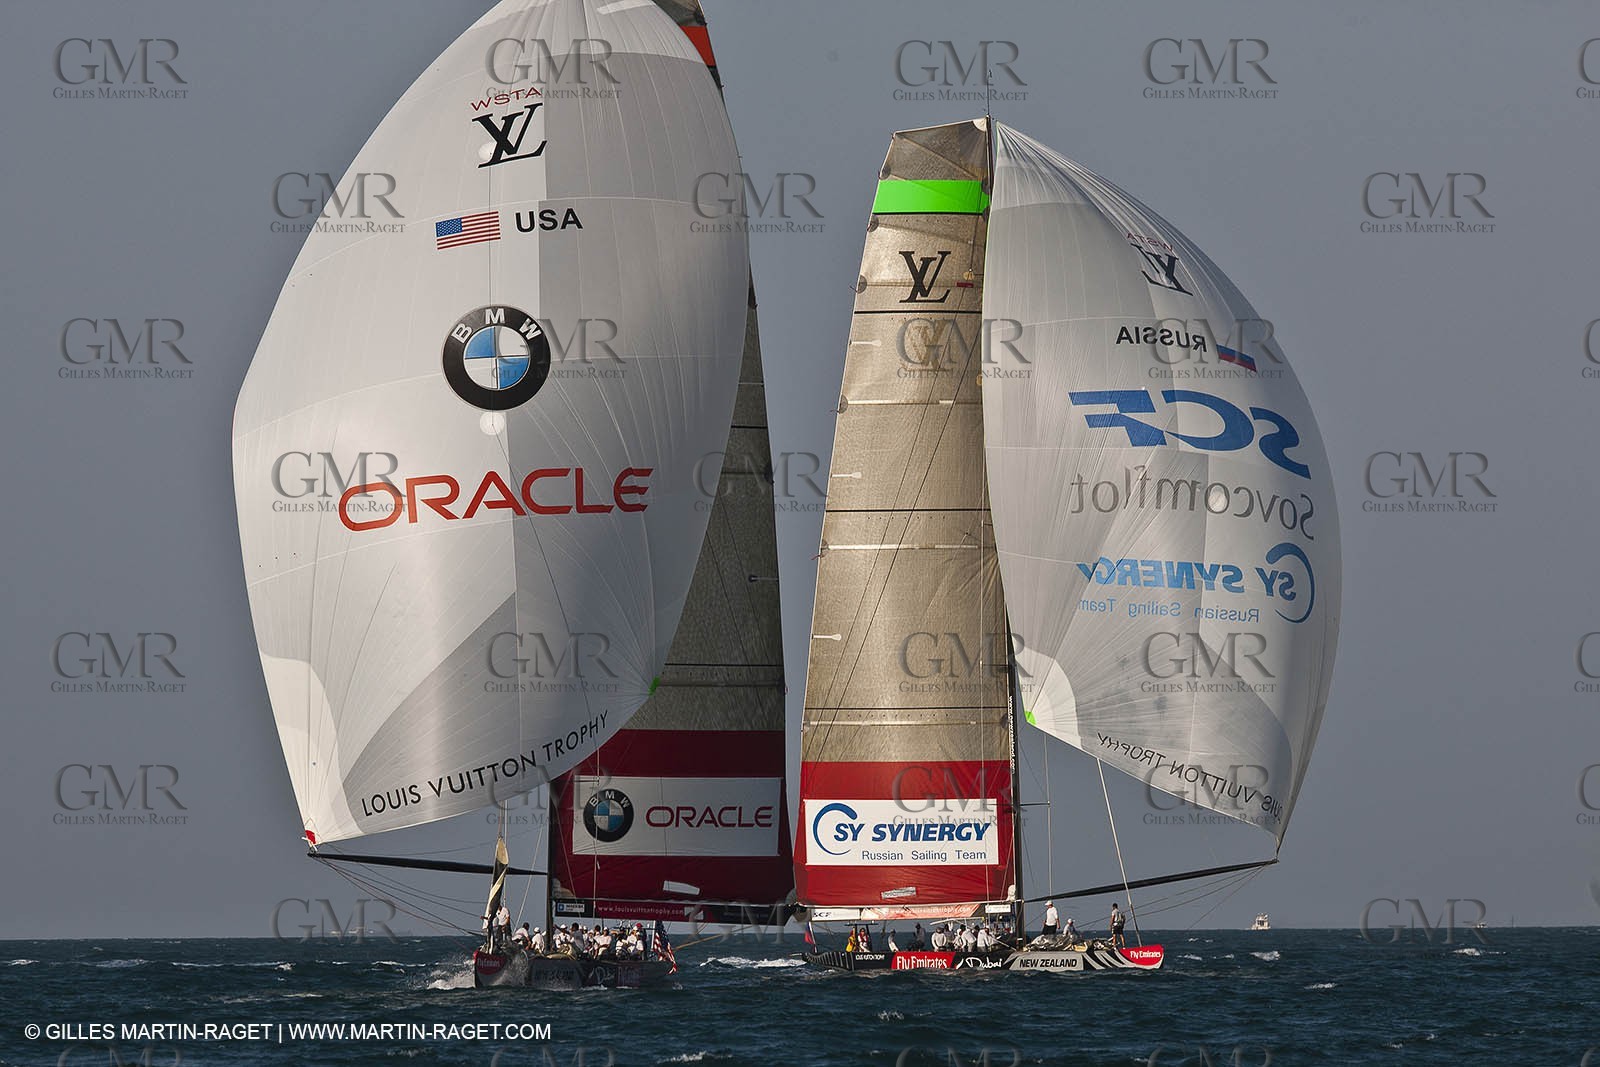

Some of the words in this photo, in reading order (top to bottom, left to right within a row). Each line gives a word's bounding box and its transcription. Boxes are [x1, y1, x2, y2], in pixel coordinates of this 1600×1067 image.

[471, 86, 541, 111] WSTA
[515, 208, 583, 233] USA
[451, 308, 542, 343] BMW
[338, 467, 654, 532] ORACLE
[361, 784, 421, 817] LOUIS
[428, 750, 537, 797] VUITTON
[542, 710, 608, 762] TROPHY
[589, 790, 630, 809] BMW
[646, 806, 773, 828] ORACLE
[834, 823, 864, 841] SY
[872, 823, 991, 841] SYNERGY
[862, 850, 903, 860] Russian
[911, 850, 947, 862] Sailing
[955, 850, 986, 860] Team
[897, 956, 910, 970] Fly
[911, 956, 947, 968] Emirates
[963, 957, 1002, 969] Dubai
[1019, 959, 1039, 968] NEW
[1040, 959, 1077, 968] ZEALAND
[1130, 950, 1138, 959] Fly
[1139, 950, 1161, 958] Emirates
